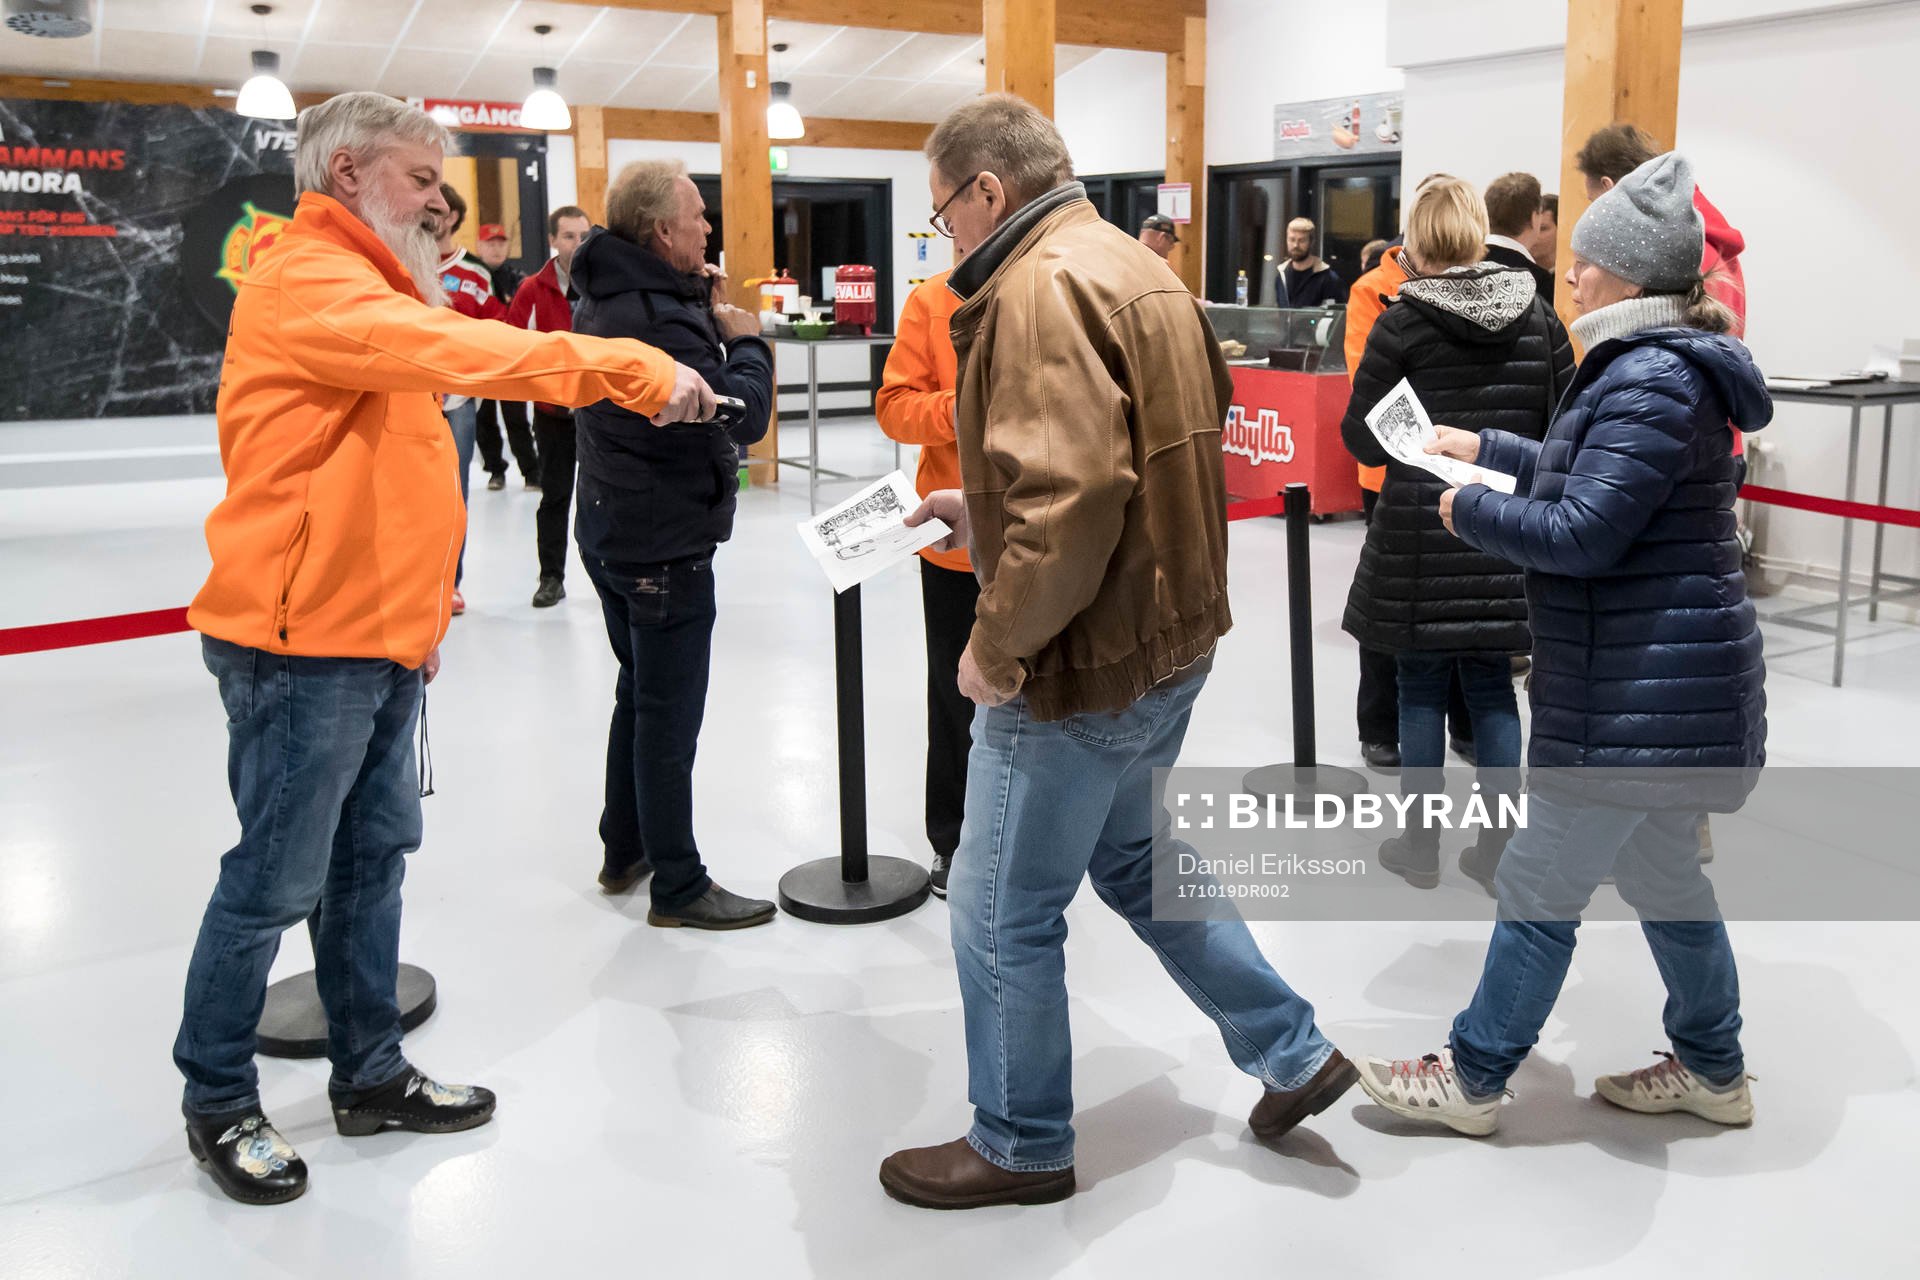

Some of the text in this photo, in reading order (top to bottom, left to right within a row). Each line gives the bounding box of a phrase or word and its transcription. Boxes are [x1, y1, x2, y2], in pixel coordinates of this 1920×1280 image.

[431, 103, 521, 127] NGÅNG
[0, 170, 83, 194] MORA
[1221, 409, 1291, 461] ibylla
